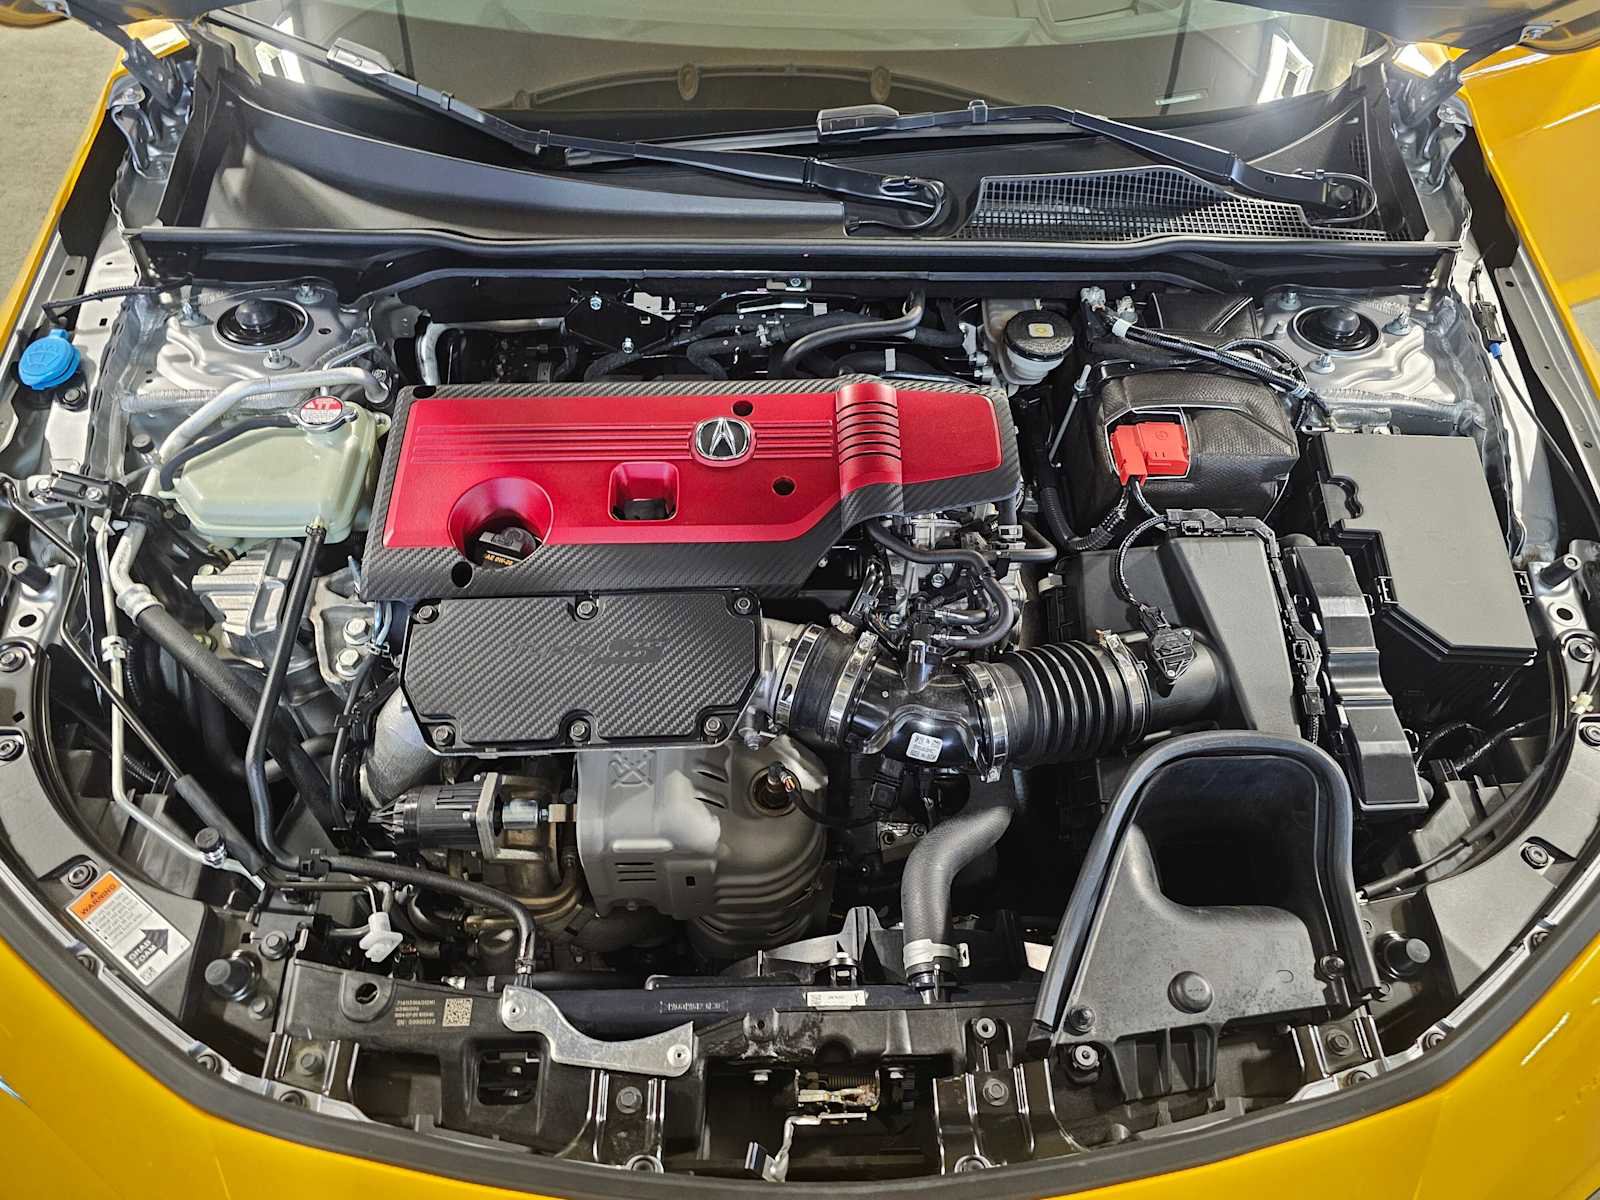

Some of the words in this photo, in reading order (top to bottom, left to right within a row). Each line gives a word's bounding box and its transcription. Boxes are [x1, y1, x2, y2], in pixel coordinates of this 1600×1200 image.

[82, 883, 116, 915] WARNING
[128, 940, 152, 960] GRAB
[134, 944, 158, 967] FOAM
